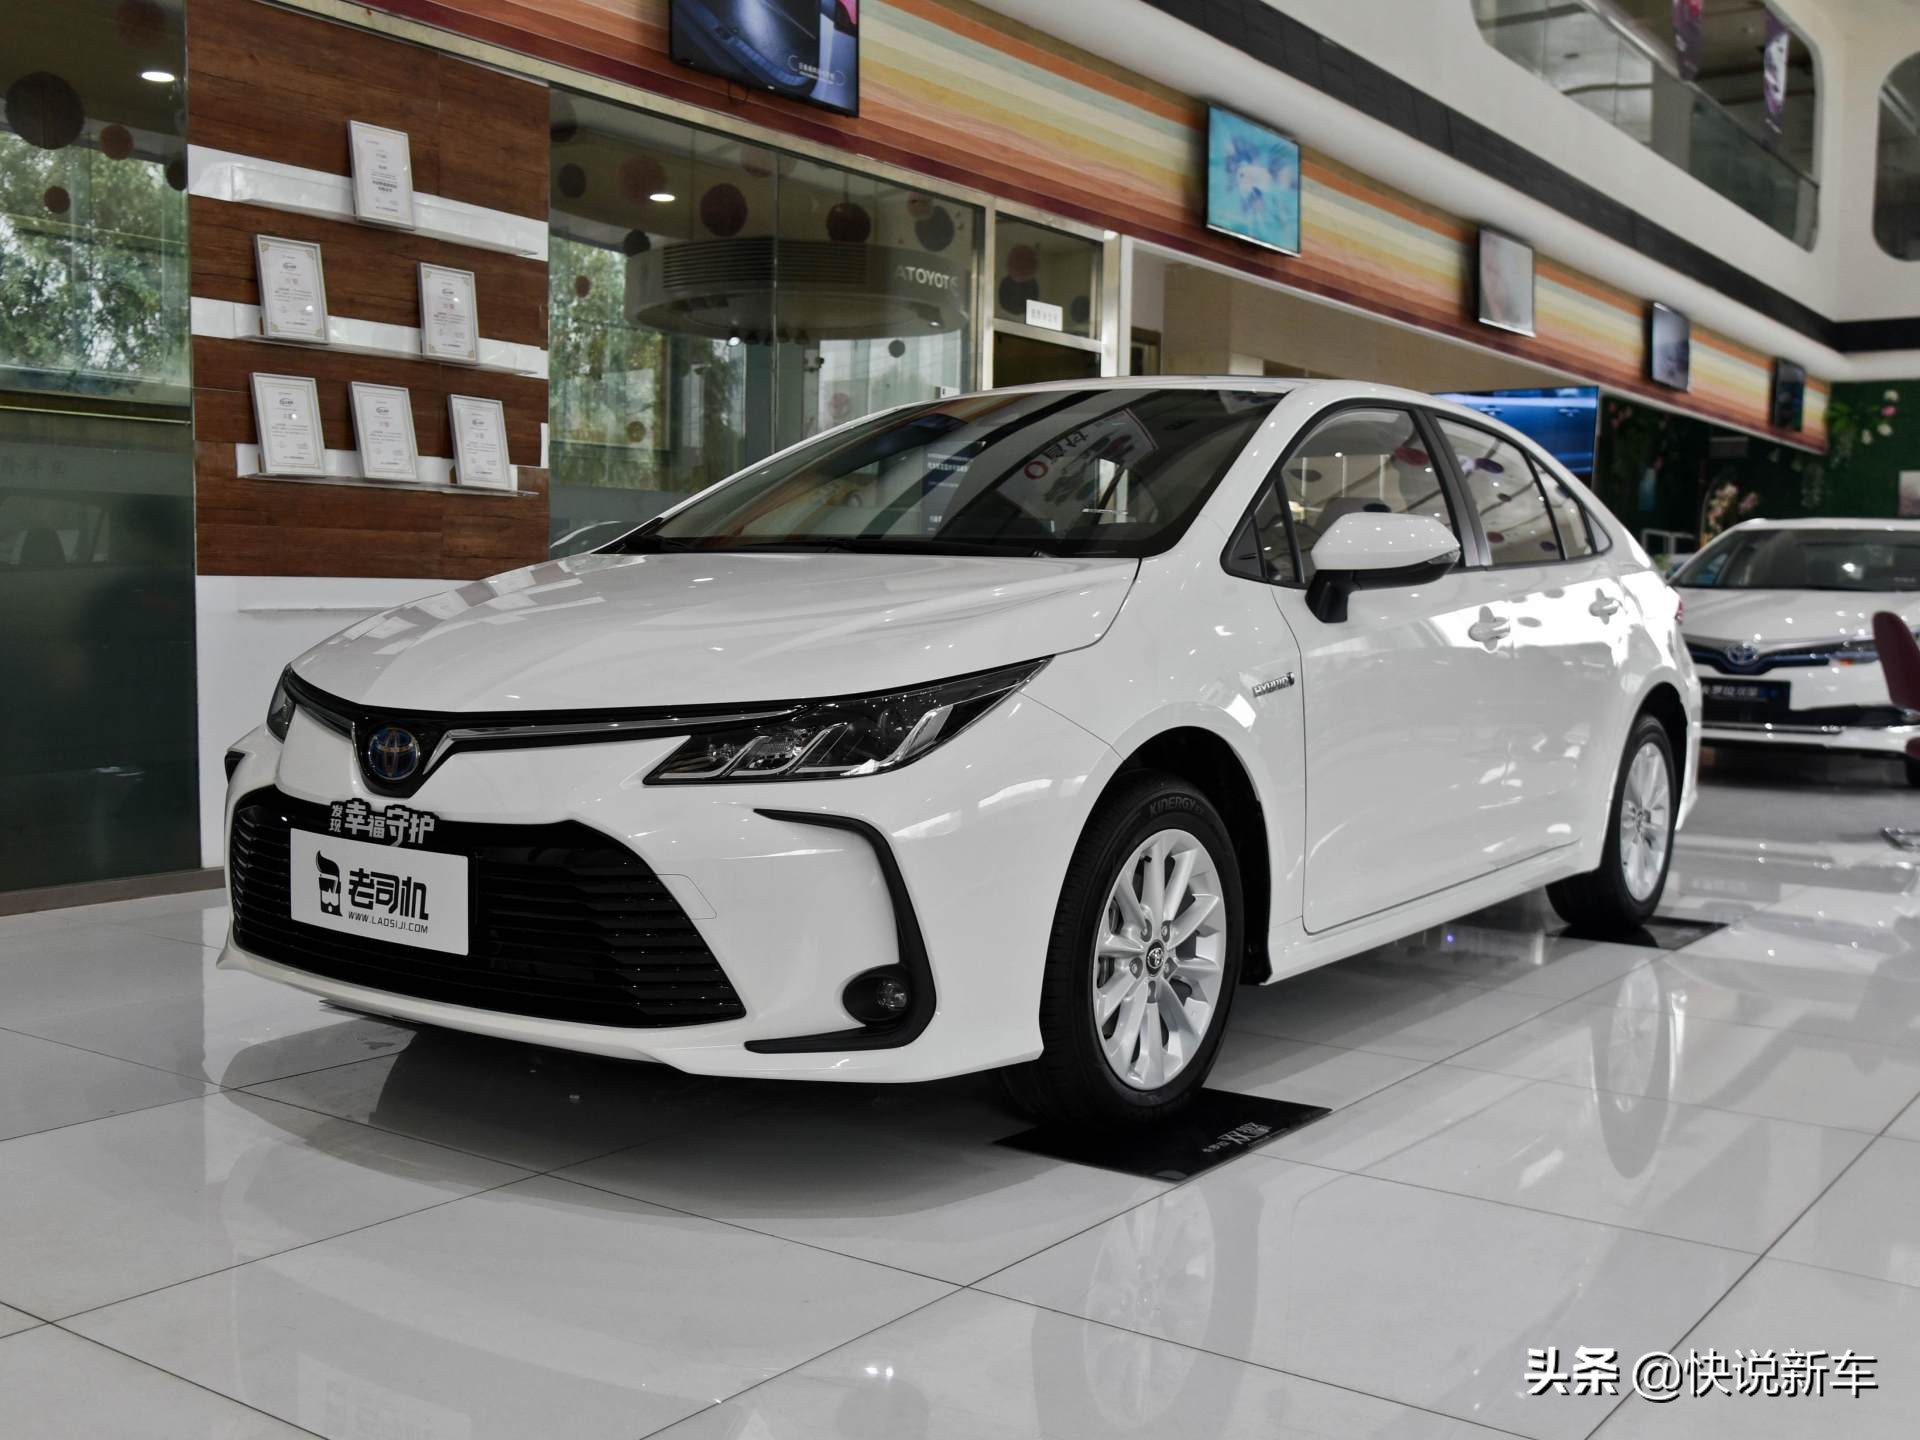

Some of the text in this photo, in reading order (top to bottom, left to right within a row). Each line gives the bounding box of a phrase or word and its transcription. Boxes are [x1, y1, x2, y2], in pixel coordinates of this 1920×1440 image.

[328, 804, 343, 832] 发现
[344, 801, 435, 847] 幸福守护
[348, 867, 429, 920] 老司机
[348, 911, 429, 934] WWW.LAOSIJI.COM
